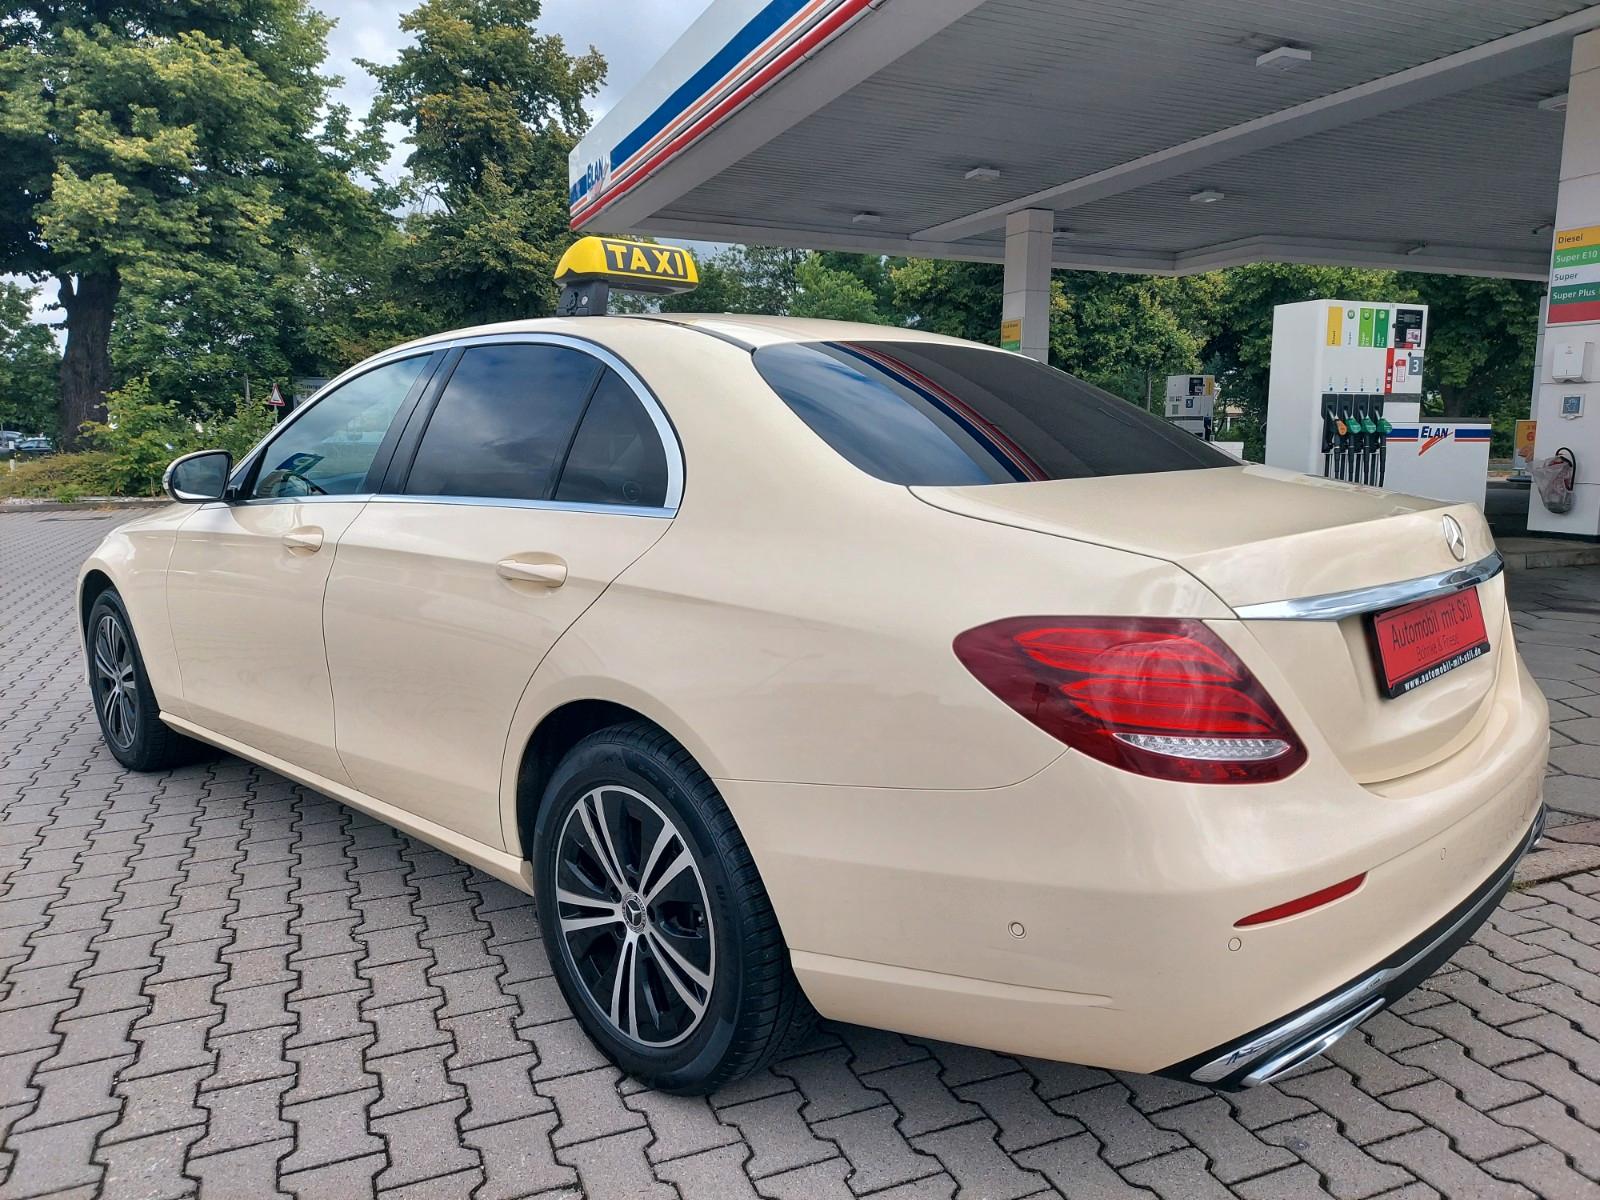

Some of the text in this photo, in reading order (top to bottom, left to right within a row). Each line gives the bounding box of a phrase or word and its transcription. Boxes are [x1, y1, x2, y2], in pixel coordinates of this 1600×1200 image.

[1558, 233, 1584, 244] Diesel
[606, 243, 684, 276] TAXI
[1556, 250, 1598, 263] Super E10
[1554, 272, 1578, 281] Super
[1552, 288, 1596, 300] Super Plus
[1412, 360, 1419, 372] 3
[1420, 425, 1449, 439] ELAN
[1391, 596, 1473, 651] Automobil mit Stil
[1404, 646, 1482, 691] www.automobil-mit-stil.de
